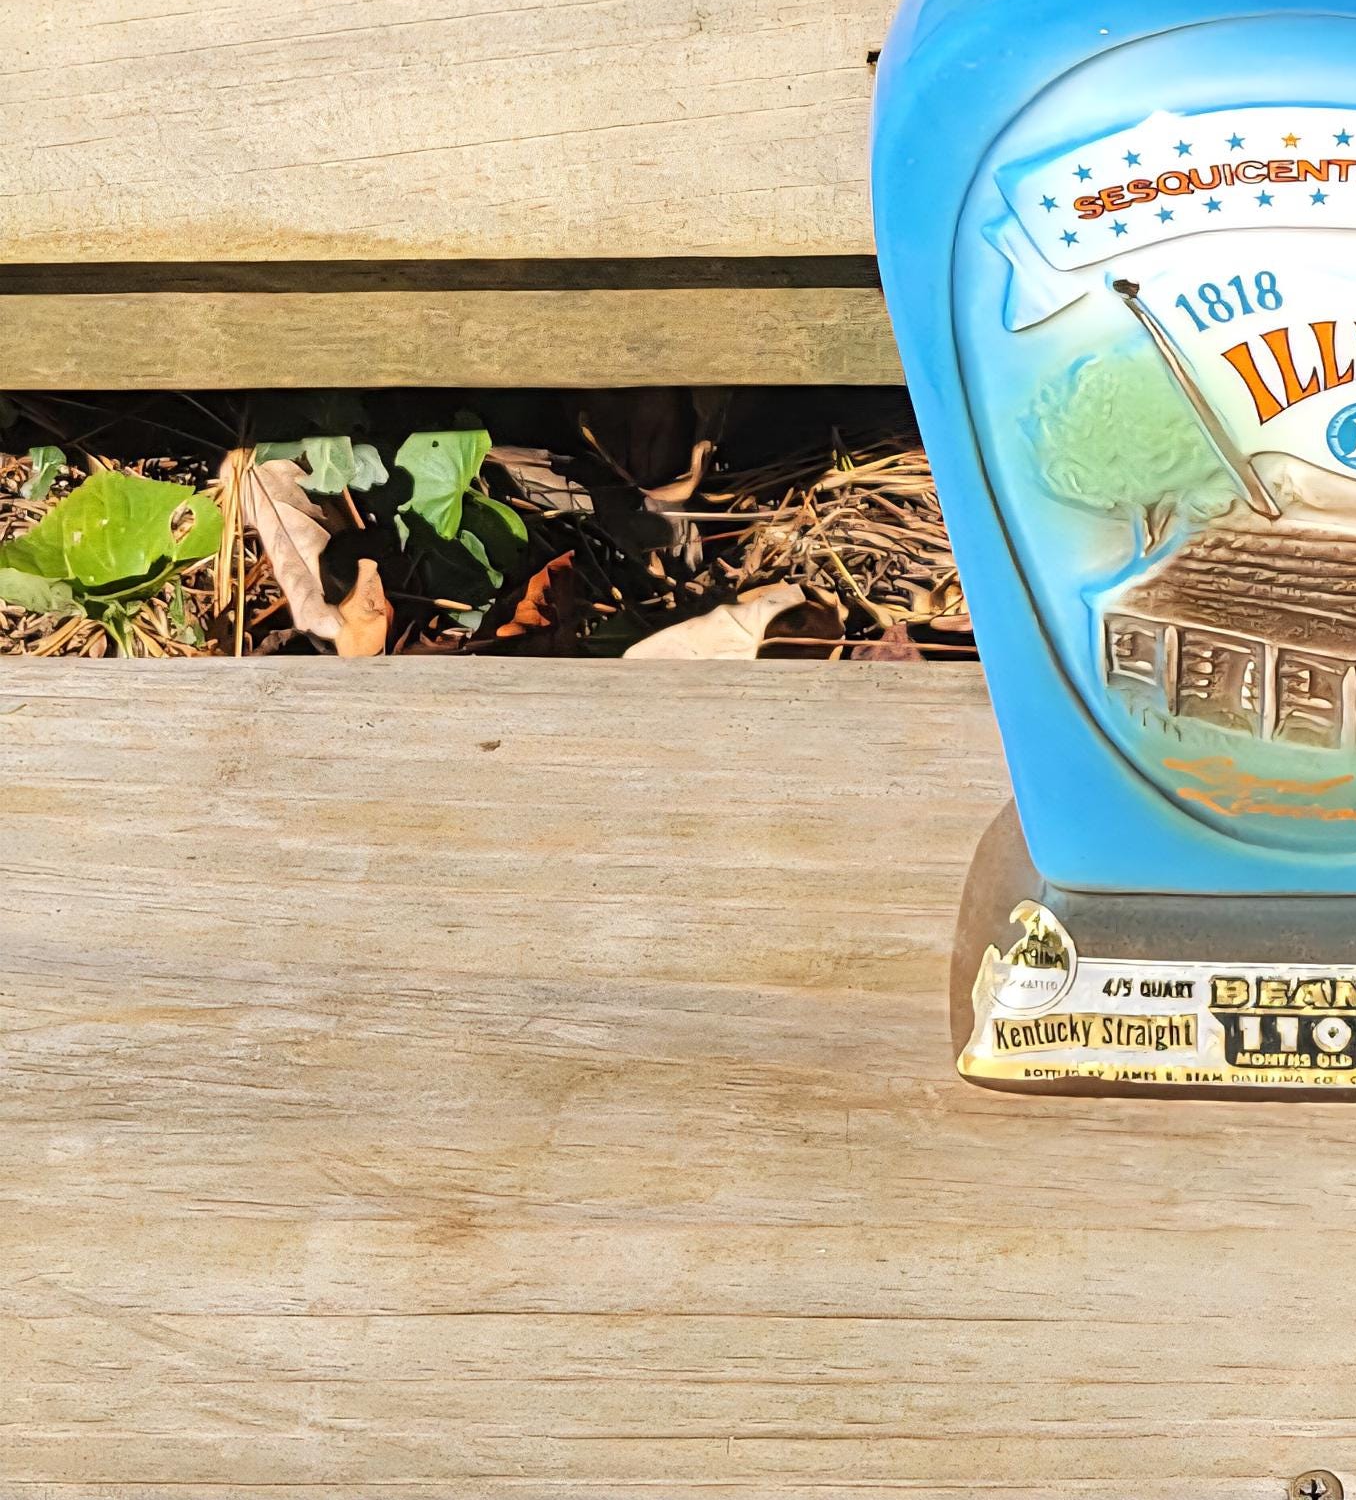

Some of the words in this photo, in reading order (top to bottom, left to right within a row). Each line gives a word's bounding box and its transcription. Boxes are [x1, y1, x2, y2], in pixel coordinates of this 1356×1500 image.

[1174, 269, 1284, 334] 1818
[1102, 976, 1134, 998] 4/5
[1139, 980, 1197, 999] QUART
[995, 1012, 1093, 1052] Kentucky
[1101, 1015, 1194, 1052] Straight
[1237, 1015, 1353, 1053] 110
[1234, 1051, 1313, 1068] MONTHS
[1316, 1052, 1354, 1069] OLD
[1185, 1073, 1224, 1083] BEAM
